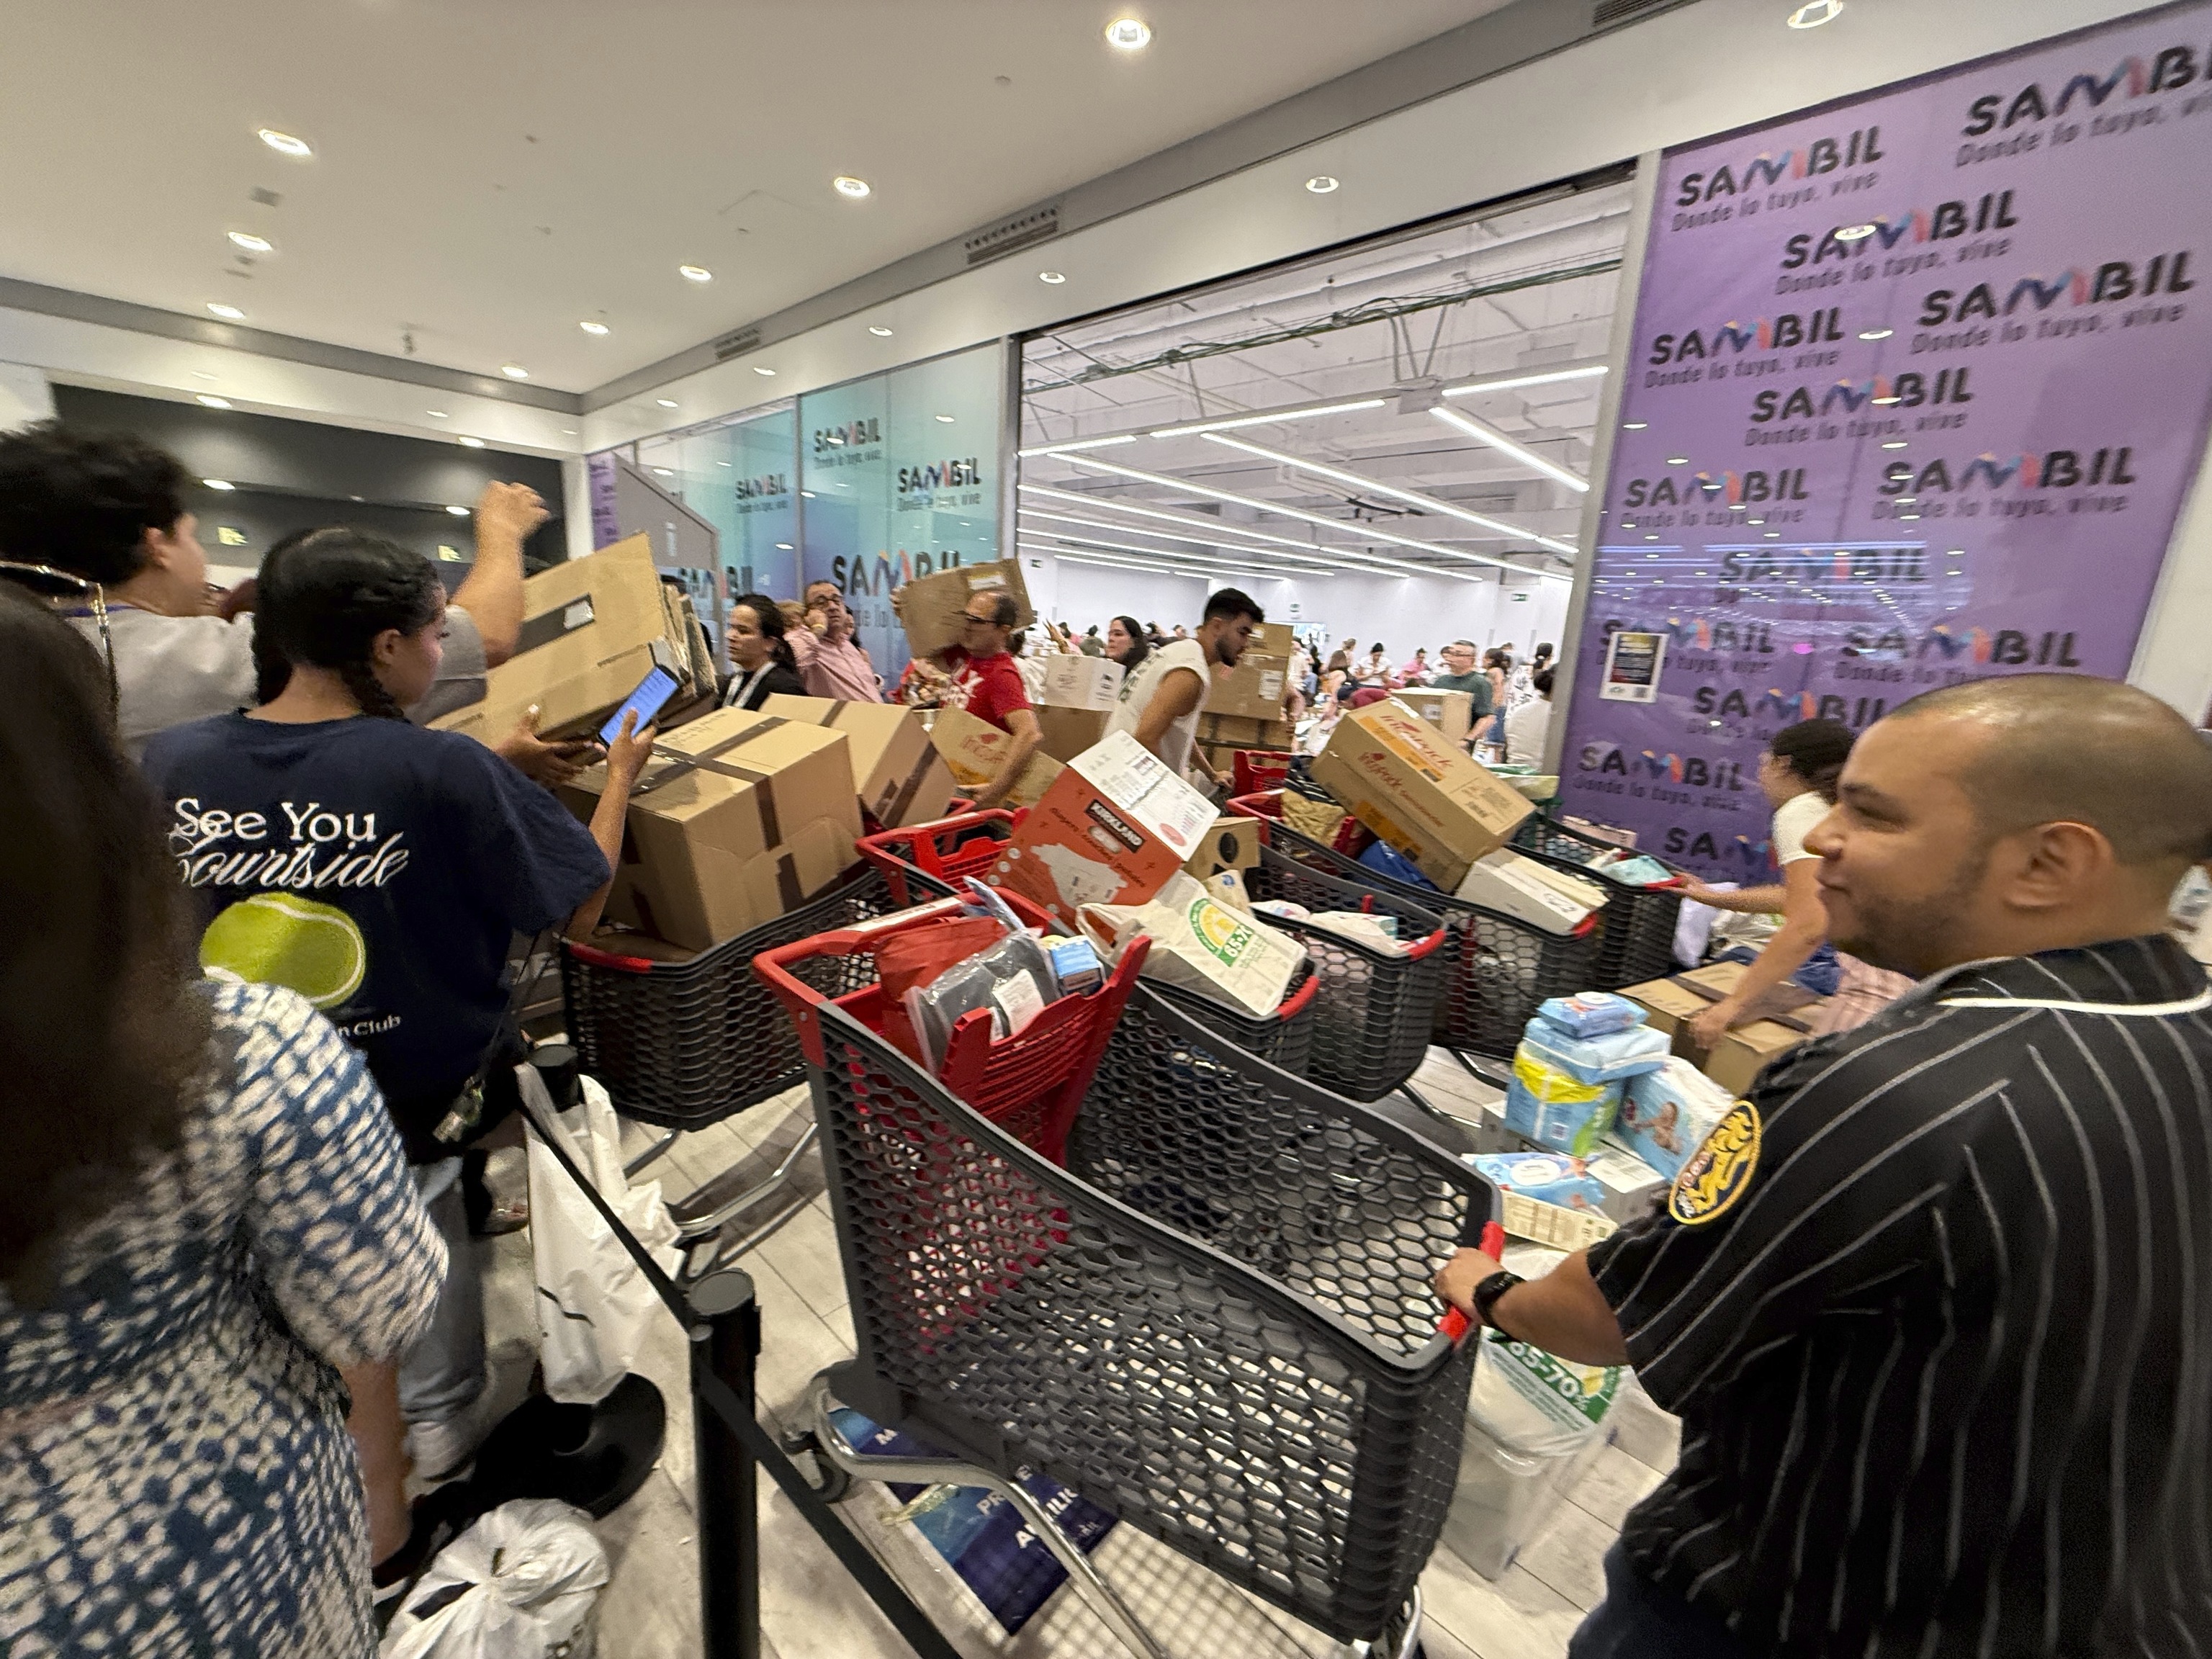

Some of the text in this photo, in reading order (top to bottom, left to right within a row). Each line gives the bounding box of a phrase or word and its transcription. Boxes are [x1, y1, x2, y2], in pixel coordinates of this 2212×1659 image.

[1676, 125, 1886, 207] SAMBIL
[1780, 189, 2018, 269] SAMBIL
[1915, 250, 2196, 327] SAMBIL
[1648, 307, 1845, 365] SAMBIL
[1750, 367, 1974, 423] SAMBIL
[897, 457, 981, 493] SAMBIL
[1624, 468, 1810, 508] SAMBIL
[1877, 447, 2136, 495] SAMBIL
[1718, 549, 1928, 582] SAMBIL
[1602, 617, 1774, 654] SMBIL
[1841, 625, 2082, 667] SAMBIL
[1578, 746, 1745, 791] SAMBIL
[175, 798, 377, 843] See You
[1665, 827, 1779, 871] SAM
[354, 1014, 401, 1036] Club
